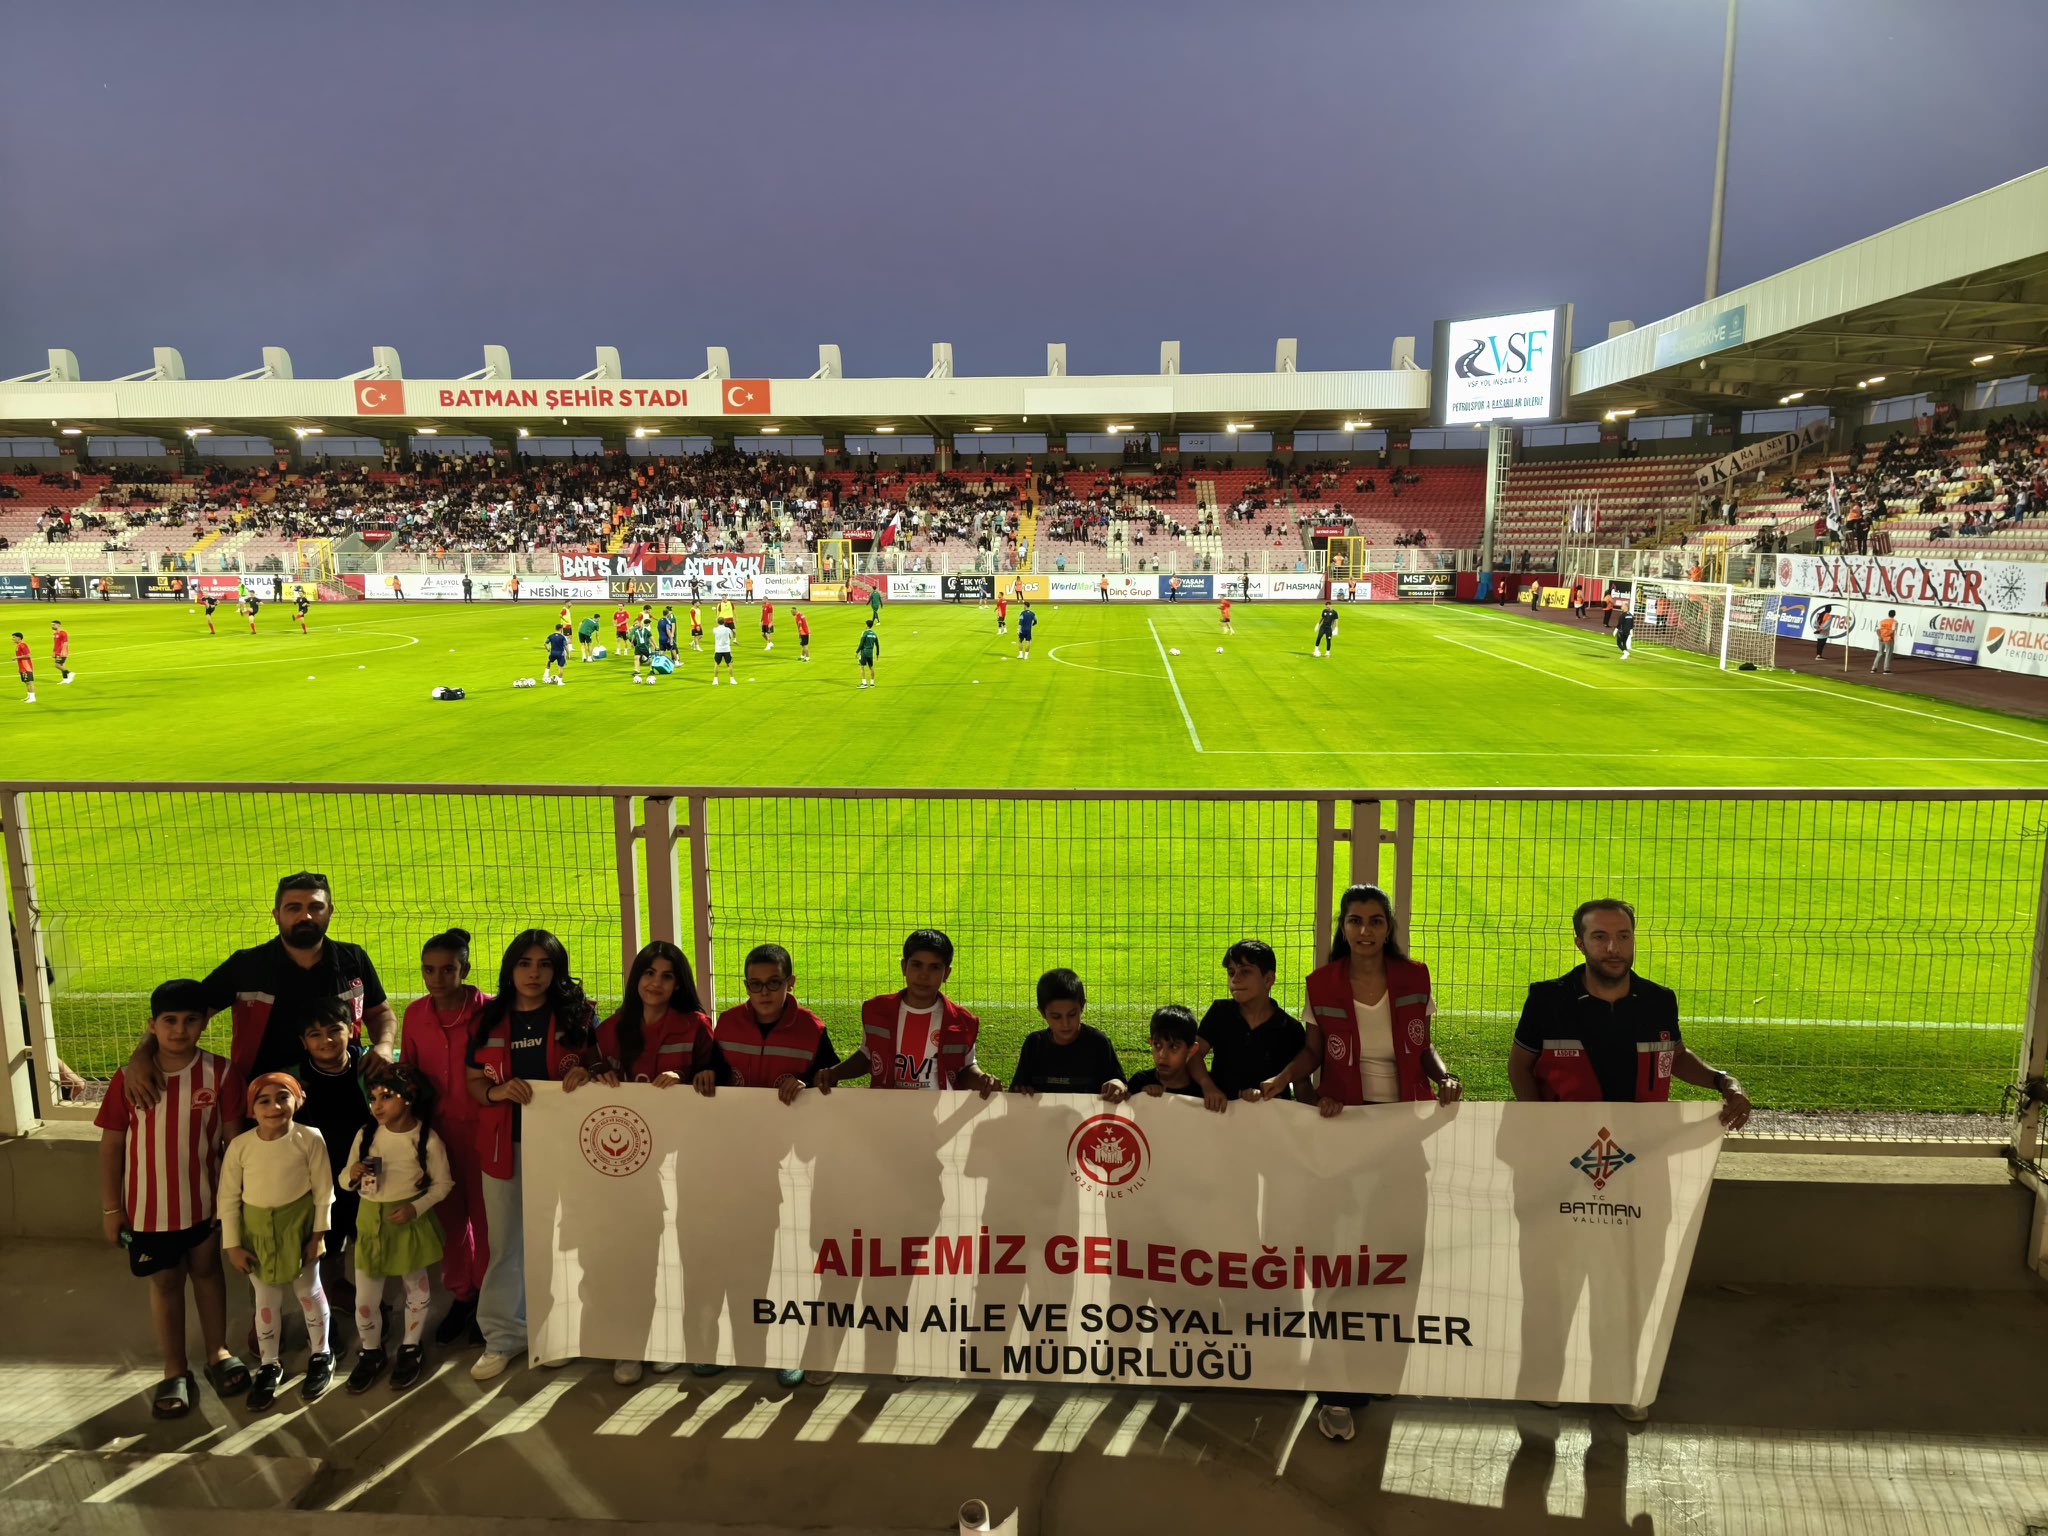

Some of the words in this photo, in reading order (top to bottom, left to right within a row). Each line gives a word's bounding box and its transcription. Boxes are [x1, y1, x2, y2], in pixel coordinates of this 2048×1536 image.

[1487, 330, 1548, 374] VSF
[439, 389, 538, 407] BATMAN
[545, 385, 614, 410] ŞEHİR
[619, 388, 688, 407] STADI
[561, 555, 612, 578] BATS
[683, 555, 762, 577] ATTACK
[1403, 574, 1426, 583] MSF
[1427, 574, 1451, 583] YAPI
[1815, 556, 1984, 605] VİKİNGLER
[530, 584, 570, 598] NESİNE
[1109, 588, 1127, 598] Dinç
[1128, 588, 1152, 597] Grup
[1939, 615, 1974, 633] ENGİN
[1070, 1169, 1092, 1192] 2025
[1127, 1176, 1147, 1194] YILI
[1560, 1201, 1642, 1219] BATMAN
[813, 1226, 1026, 1277] AİLEMİZ
[1044, 1234, 1408, 1290] GELECEĞİMİZ
[753, 1298, 909, 1333] BATMAN
[920, 1298, 1006, 1332] AİLE
[1018, 1303, 1067, 1332] VE
[1080, 1303, 1233, 1335] SOSYAL
[1246, 1306, 1474, 1346] HİZMETLER
[959, 1339, 991, 1373] İL
[1003, 1338, 1252, 1381] MÜDÜRLÜĞÜ
